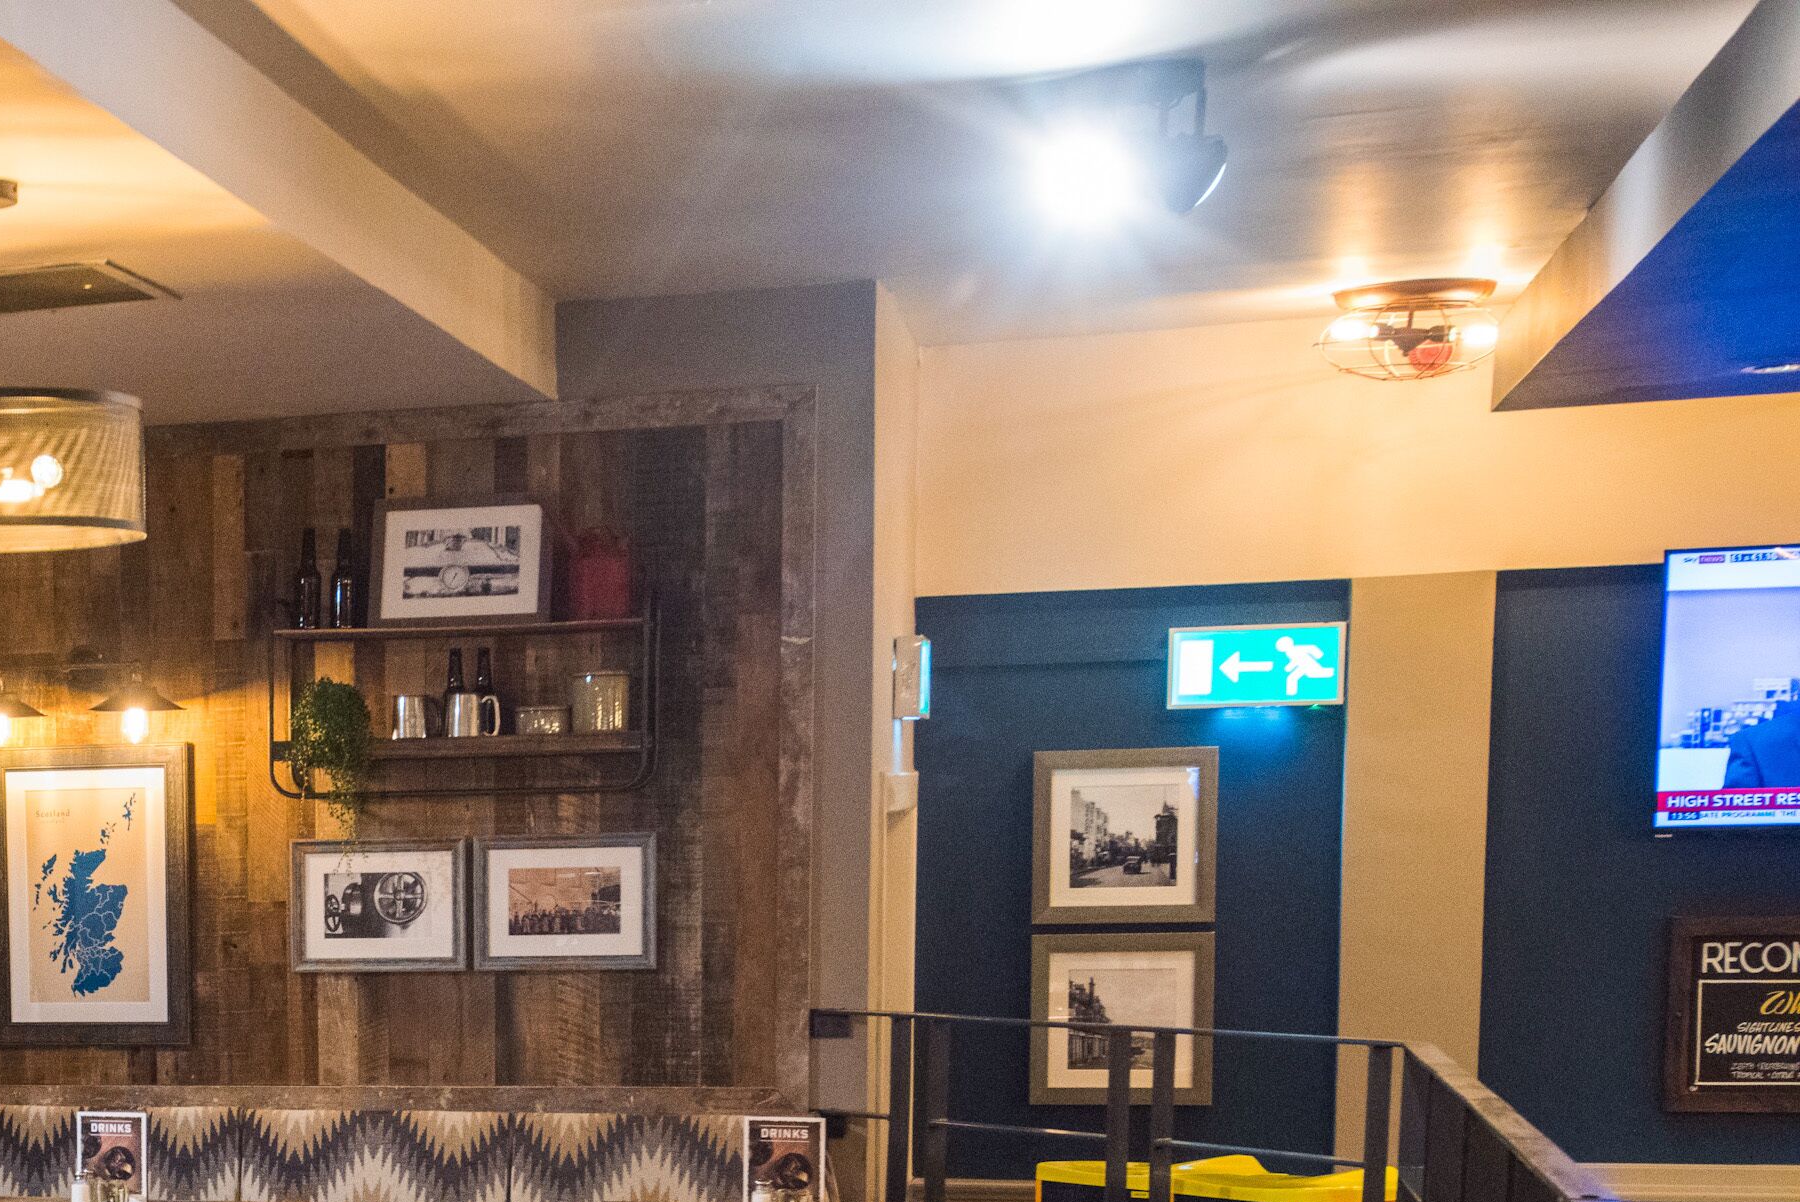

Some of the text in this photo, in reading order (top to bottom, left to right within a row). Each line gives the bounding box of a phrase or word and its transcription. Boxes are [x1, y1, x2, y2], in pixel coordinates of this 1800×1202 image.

[1667, 795, 1709, 808] HIGH
[1712, 793, 1773, 807] STREET
[1705, 1033, 1800, 1055] SAUVIGNON
[90, 1122, 132, 1133] DRINKS
[760, 1128, 809, 1139] DRINKS
